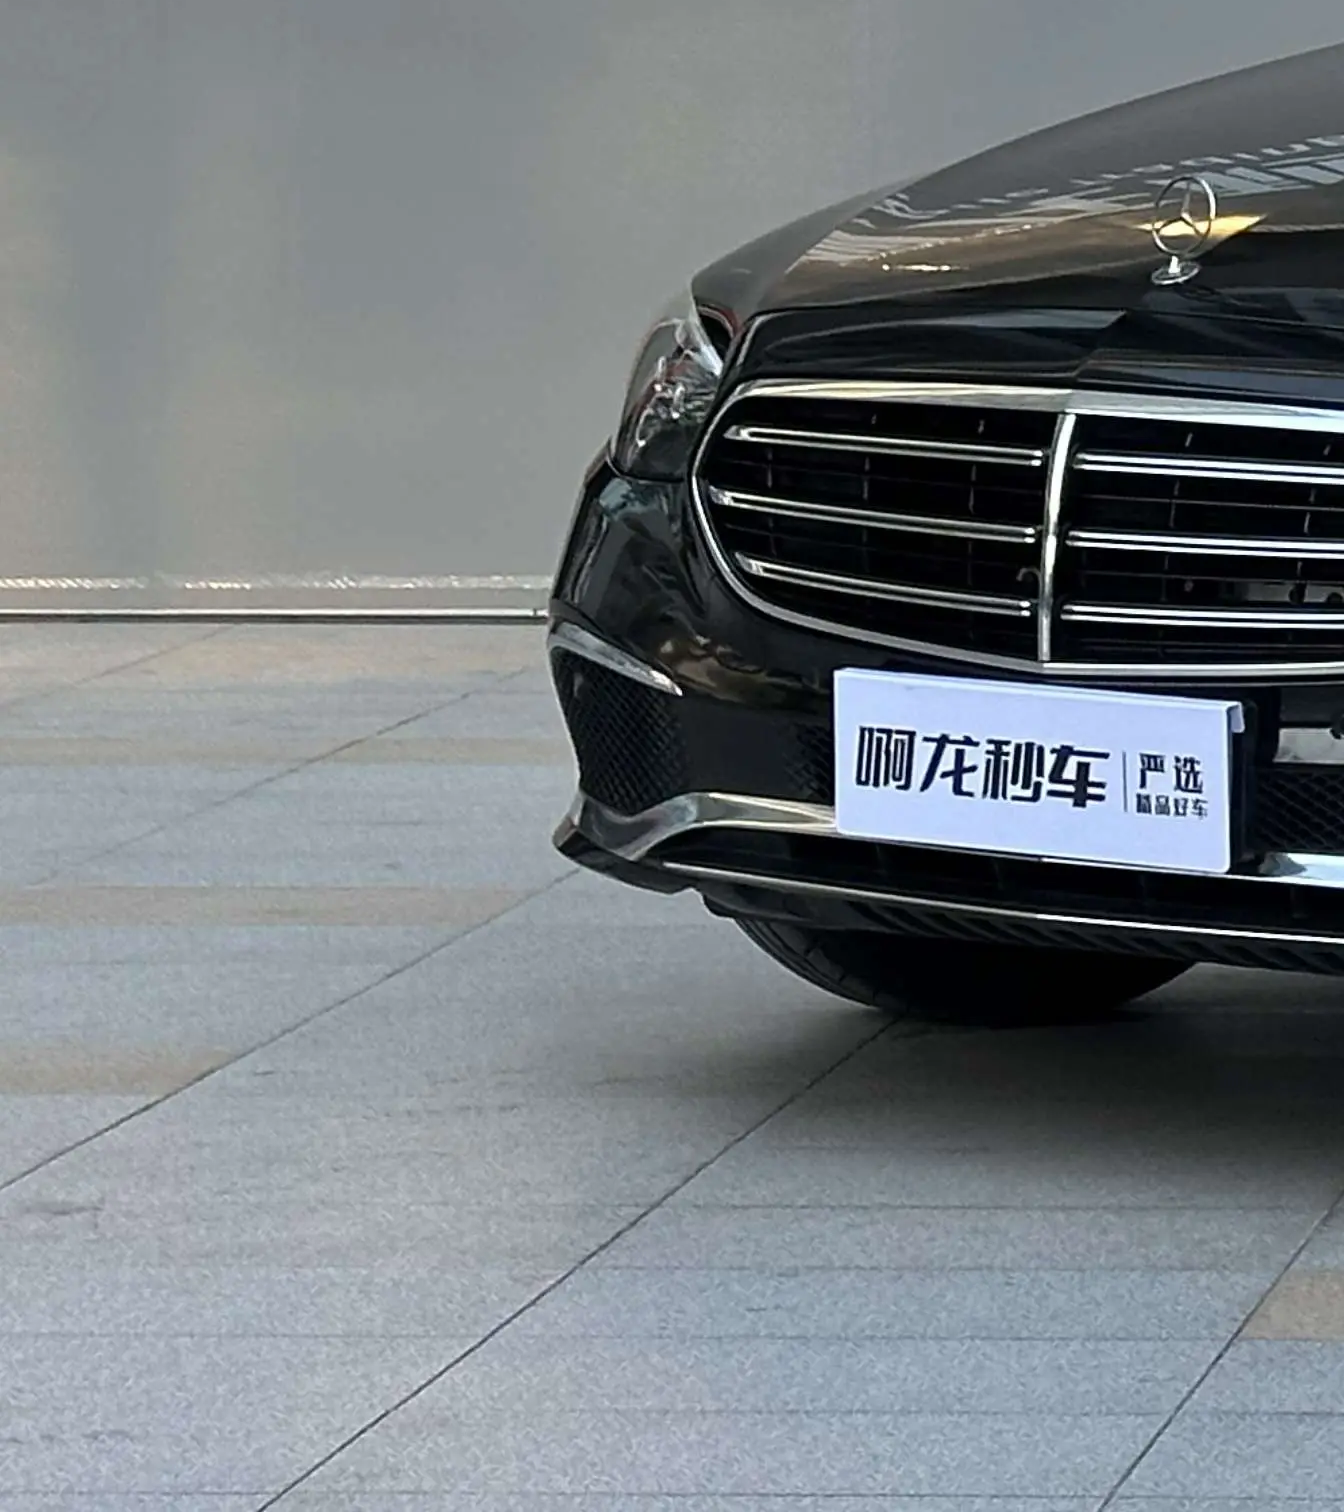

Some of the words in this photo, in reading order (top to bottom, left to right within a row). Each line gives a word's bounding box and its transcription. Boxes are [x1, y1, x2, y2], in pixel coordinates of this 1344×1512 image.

[855, 725, 1111, 808] 啊龙秒车
[1138, 752, 1204, 794] 严选
